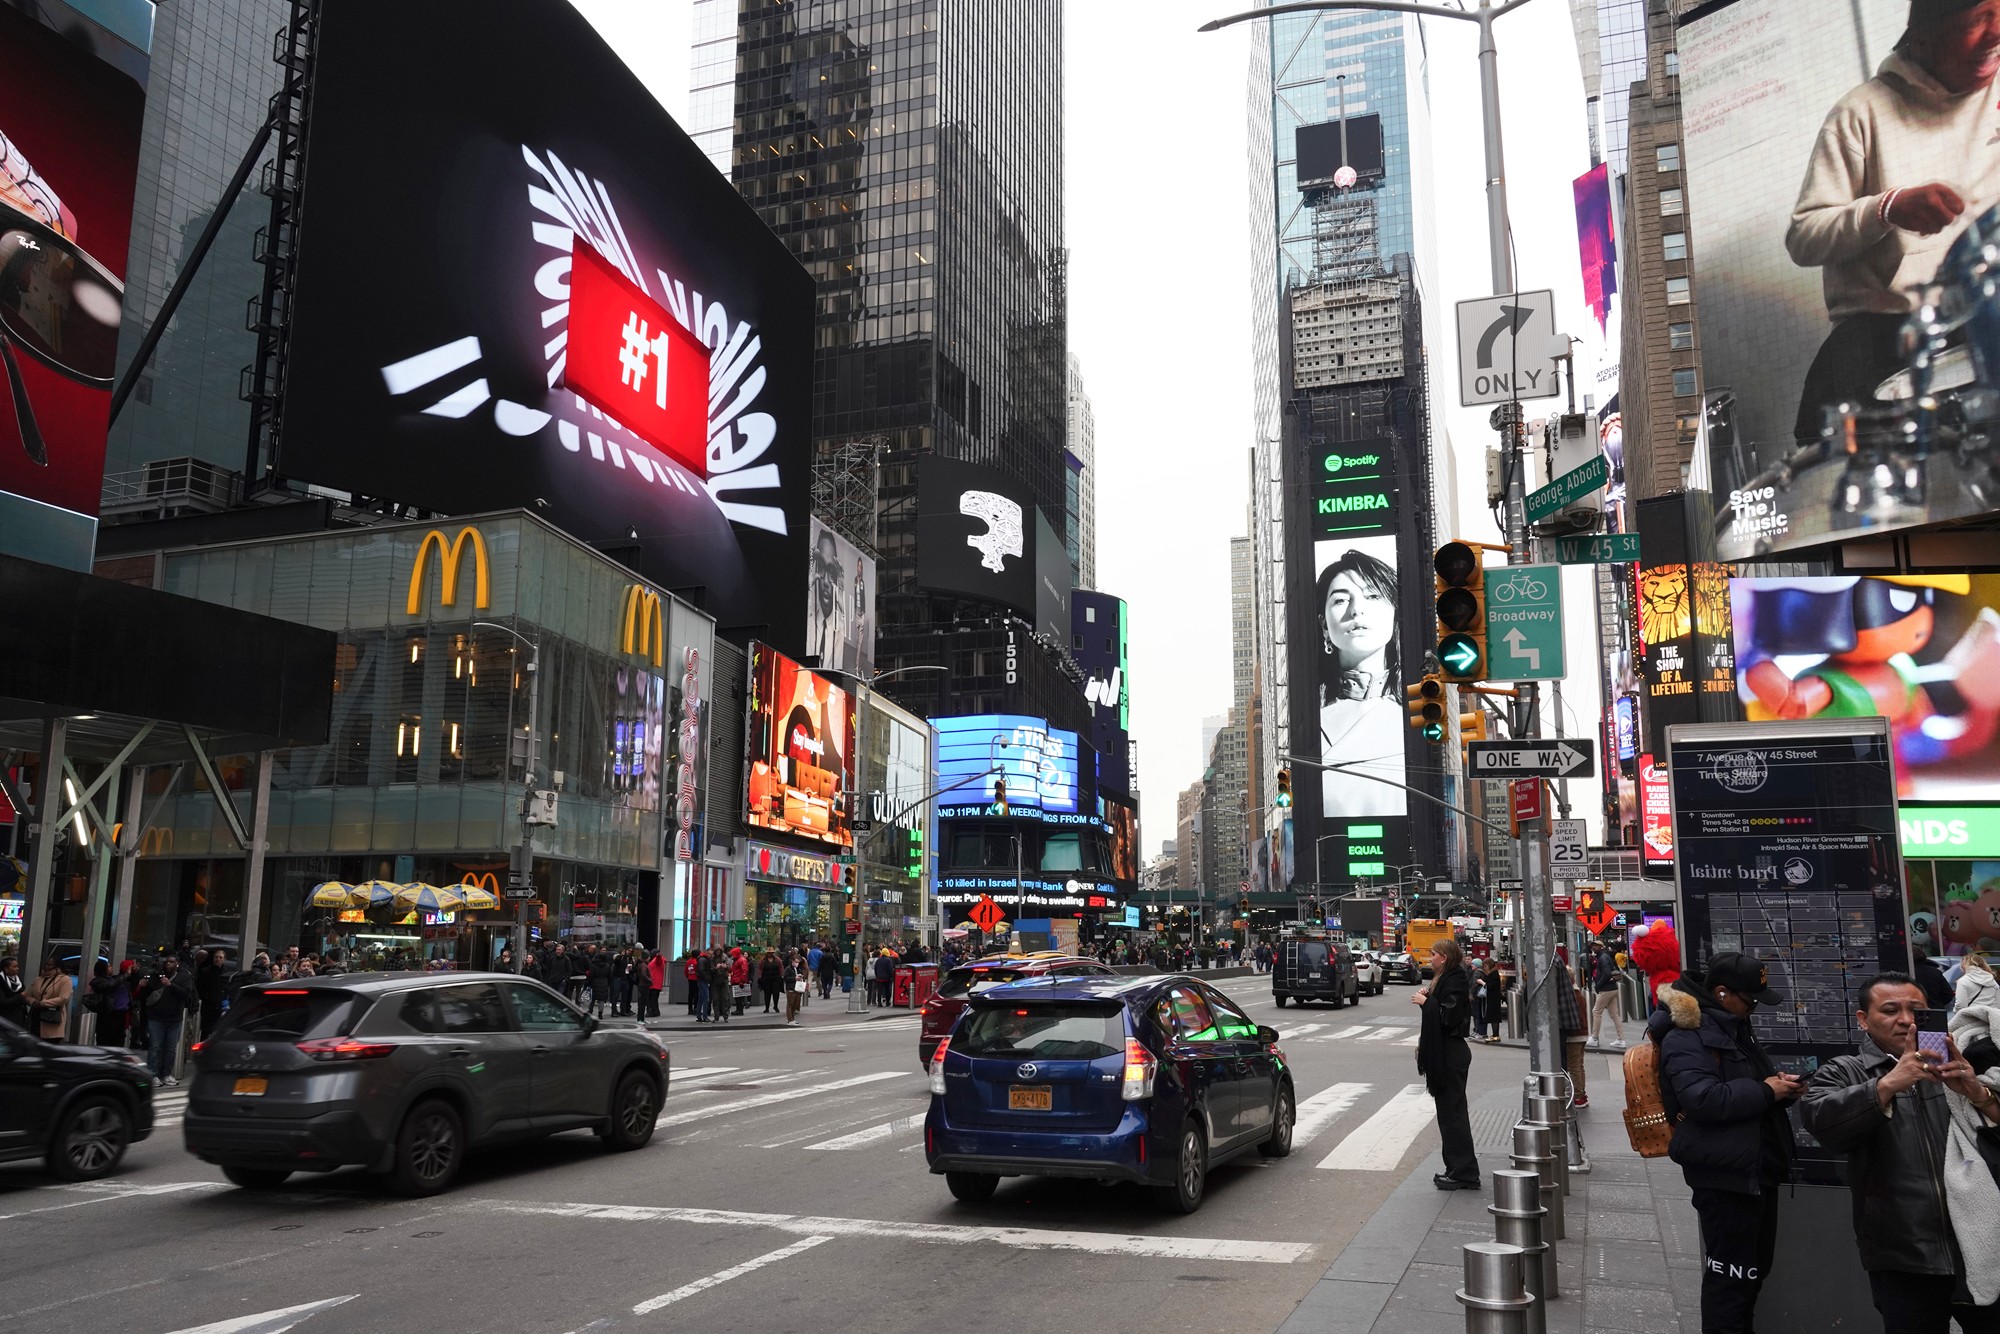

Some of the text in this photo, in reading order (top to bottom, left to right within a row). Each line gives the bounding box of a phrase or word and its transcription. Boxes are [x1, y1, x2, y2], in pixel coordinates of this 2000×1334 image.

[619, 310, 669, 411] #1
[1475, 368, 1542, 396] ONLY
[1344, 455, 1379, 468] Spotify
[1528, 460, 1601, 512] George Abbott
[1560, 494, 1571, 505] Way
[1730, 486, 1774, 506] Save
[1318, 494, 1389, 514] KIMBRA
[1731, 502, 1768, 520] The
[1732, 514, 1788, 536] Music
[1734, 527, 1788, 542] FOUNDATION
[1561, 537, 1636, 561] W 45 St
[1489, 610, 1555, 622] Broadway
[1006, 632, 1016, 684] 1500
[1660, 646, 1678, 658] THE
[1656, 658, 1684, 672] SHOW
[1661, 670, 1682, 682] OF A
[1651, 681, 1693, 696] LIFETIME
[794, 728, 804, 750] Stay
[1486, 752, 1575, 767] ONE WAY
[1697, 750, 1818, 762] 7 Avenue & W 45 Street
[1698, 769, 1768, 780] Times Square
[874, 790, 920, 832] OLD NAVY
[938, 808, 954, 818] AND
[956, 808, 980, 816] 11PM
[1060, 815, 1086, 824] FROM
[1348, 846, 1384, 855] EQUAL
[1554, 844, 1584, 860] 25
[768, 851, 789, 878] NY
[792, 856, 825, 883] GIFTS
[955, 879, 975, 887] killed
[978, 879, 986, 887] in
[989, 879, 1016, 887] Israeli
[883, 890, 903, 904] OLD NAVY
[993, 895, 1026, 904] surgey
[1049, 896, 1084, 907] swelling
